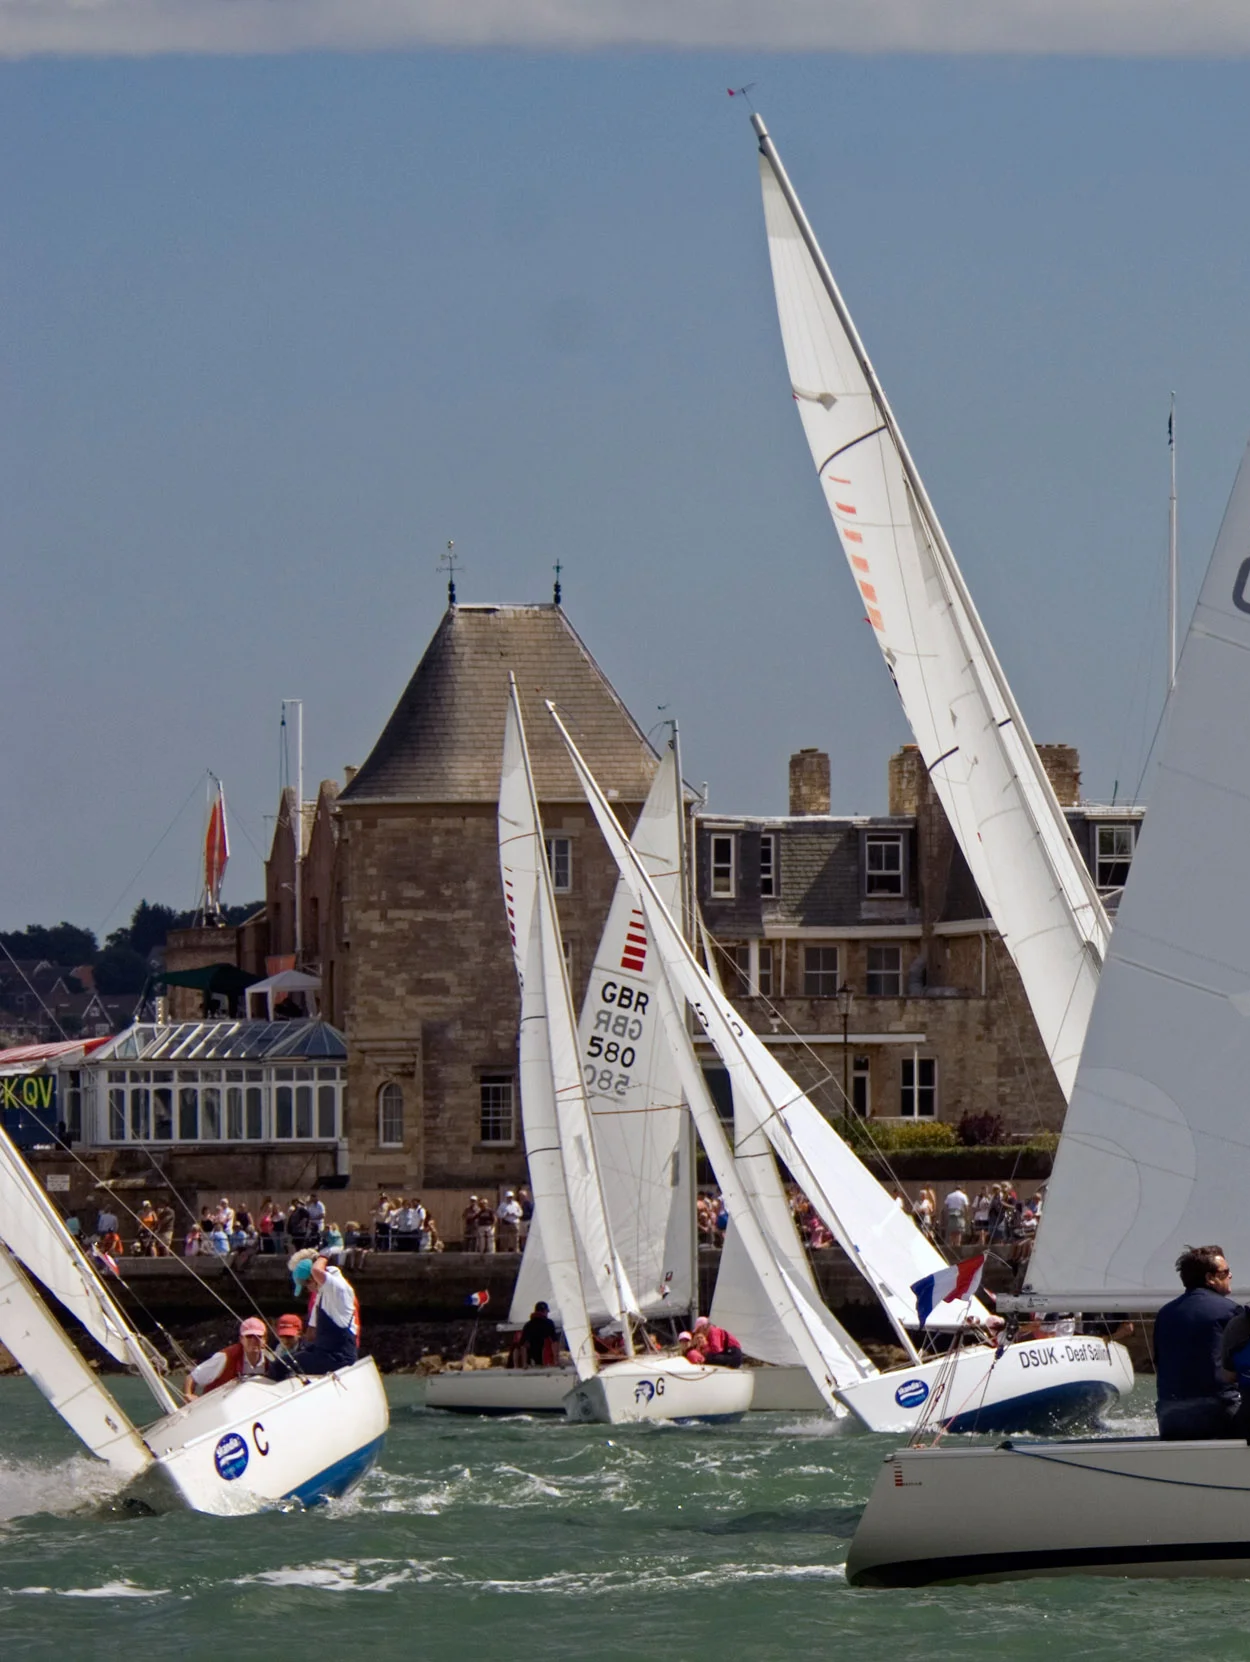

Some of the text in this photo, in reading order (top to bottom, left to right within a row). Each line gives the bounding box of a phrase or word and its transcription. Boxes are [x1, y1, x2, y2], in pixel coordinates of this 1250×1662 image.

[601, 981, 649, 1014] GBR
[586, 1036, 636, 1068] 580
[1019, 1346, 1059, 1369] DSUK
[1065, 1343, 1088, 1362] Deaf
[656, 1377, 665, 1396] G
[252, 1422, 269, 1456] C
